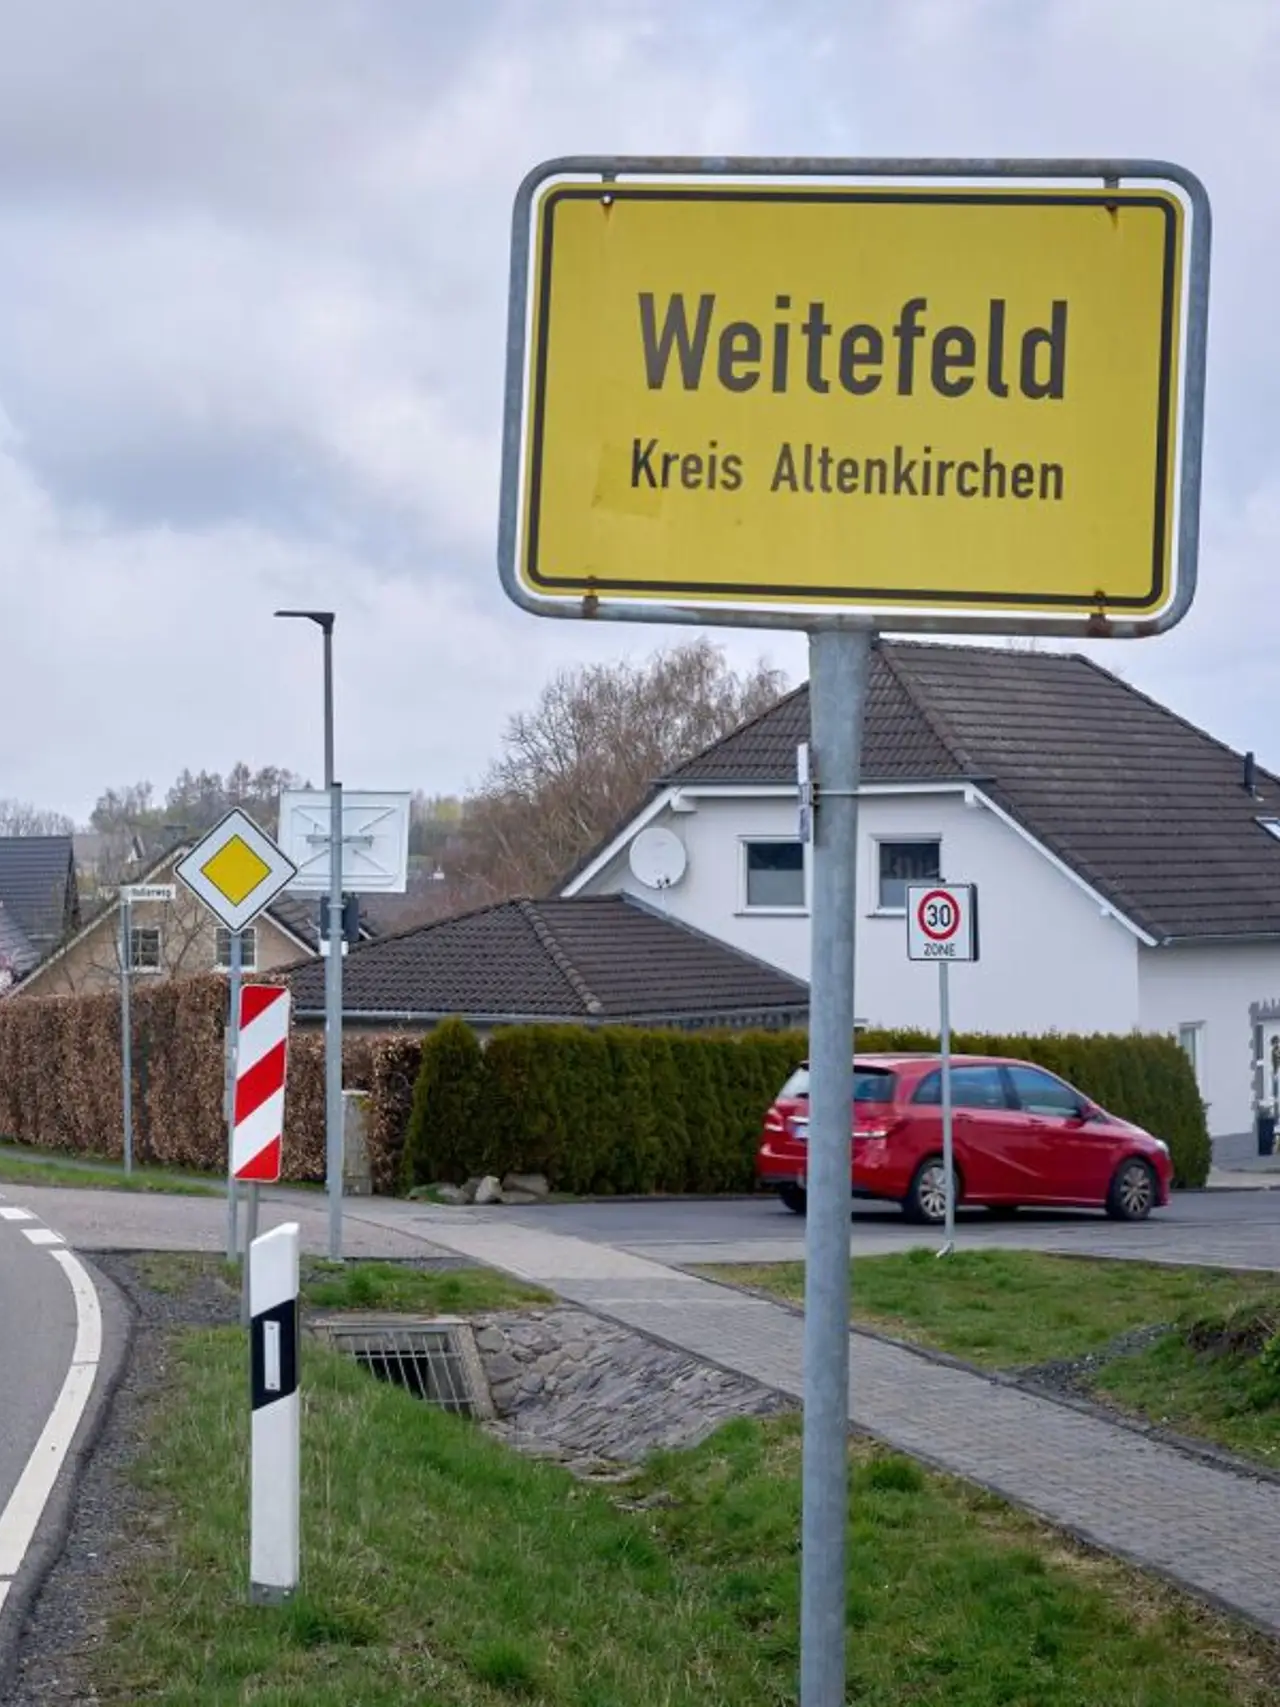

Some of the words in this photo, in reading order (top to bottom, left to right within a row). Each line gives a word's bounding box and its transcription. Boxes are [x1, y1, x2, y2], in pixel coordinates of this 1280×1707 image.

[638, 292, 1068, 400] Weitefeld
[631, 438, 742, 491] Kreis
[770, 442, 1064, 500] Altenkirchen
[927, 904, 951, 927] 30
[923, 943, 956, 957] ZONE
